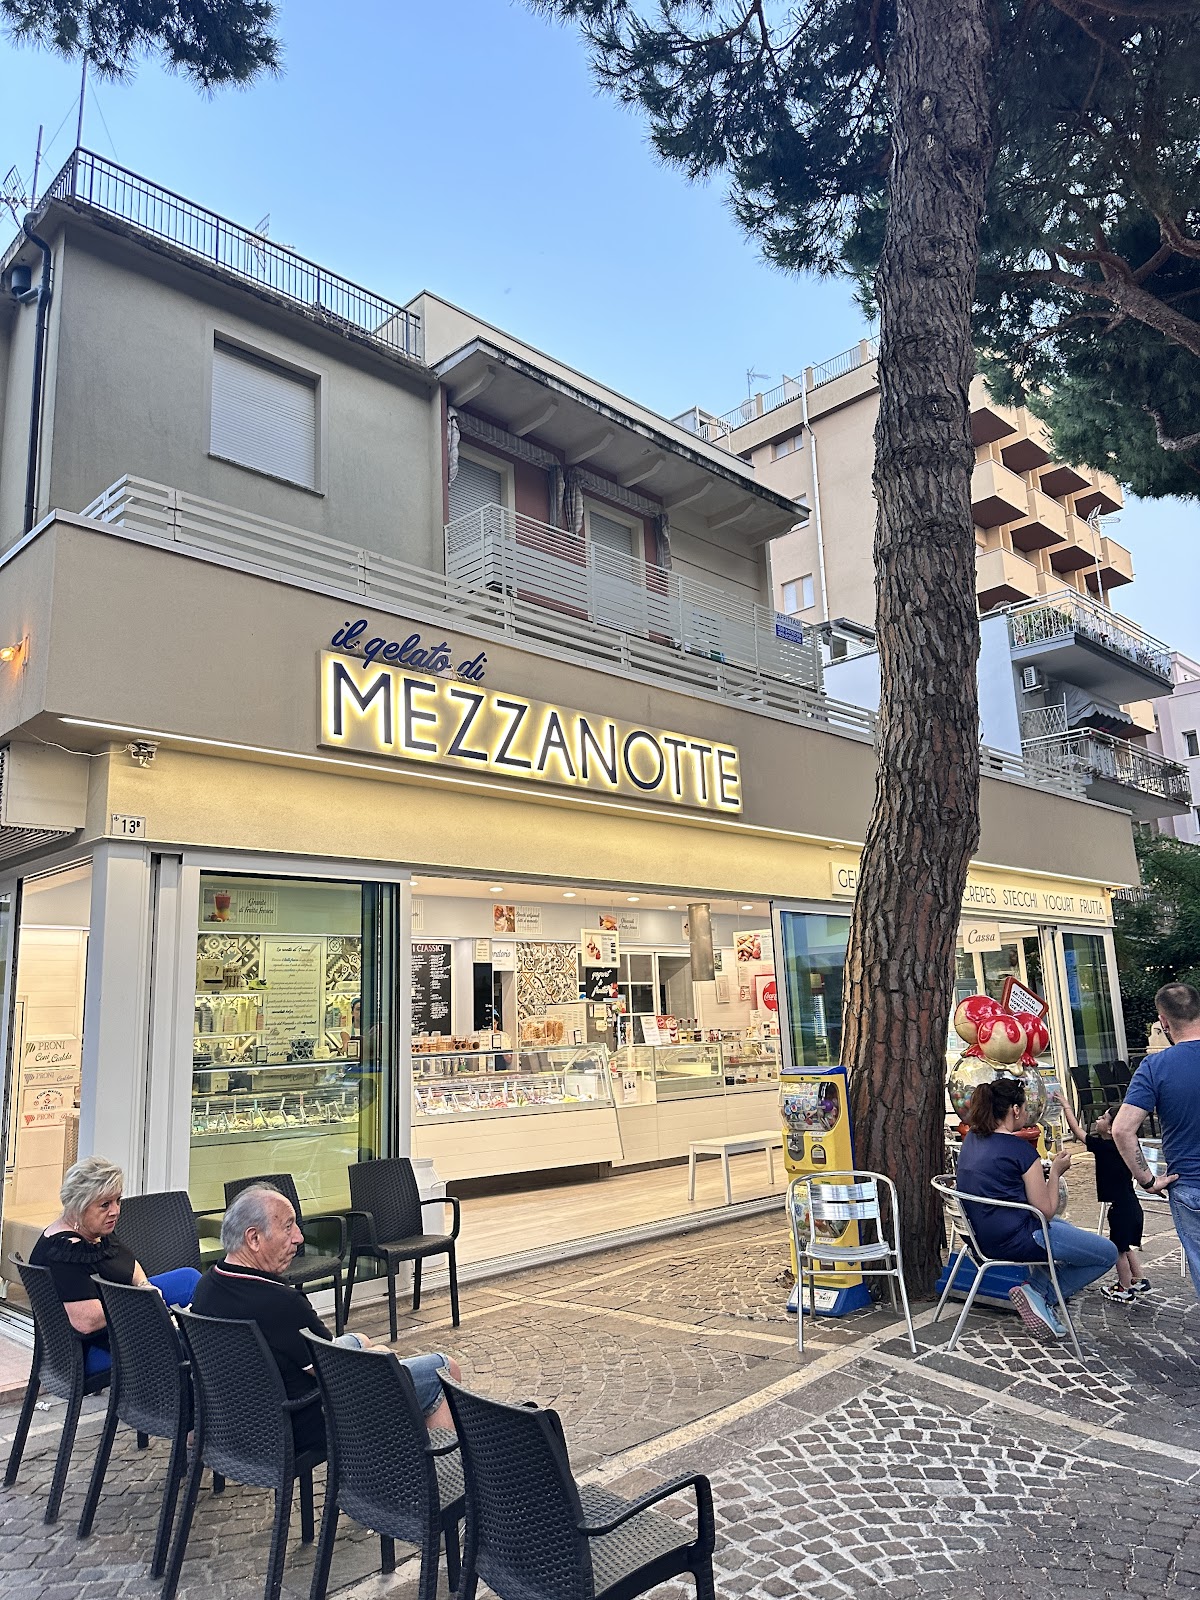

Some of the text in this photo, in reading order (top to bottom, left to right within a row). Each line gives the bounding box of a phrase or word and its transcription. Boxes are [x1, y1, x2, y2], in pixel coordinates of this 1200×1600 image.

[331, 619, 488, 681] il gelato di
[332, 661, 740, 806] MEZZANOTTE
[1002, 889, 1038, 908] STECCHI
[1042, 893, 1075, 912] YOGURT
[1079, 898, 1105, 915] FRUTTA
[967, 929, 996, 945] Cassa
[416, 944, 444, 953] CLASSICI
[1012, 990, 1039, 1013] ARTIGIANALE
[1019, 990, 1036, 1005] GELATO
[38, 1041, 66, 1051] PRONI
[36, 1072, 54, 1080] PRONI
[36, 1113, 55, 1121] PRONI
